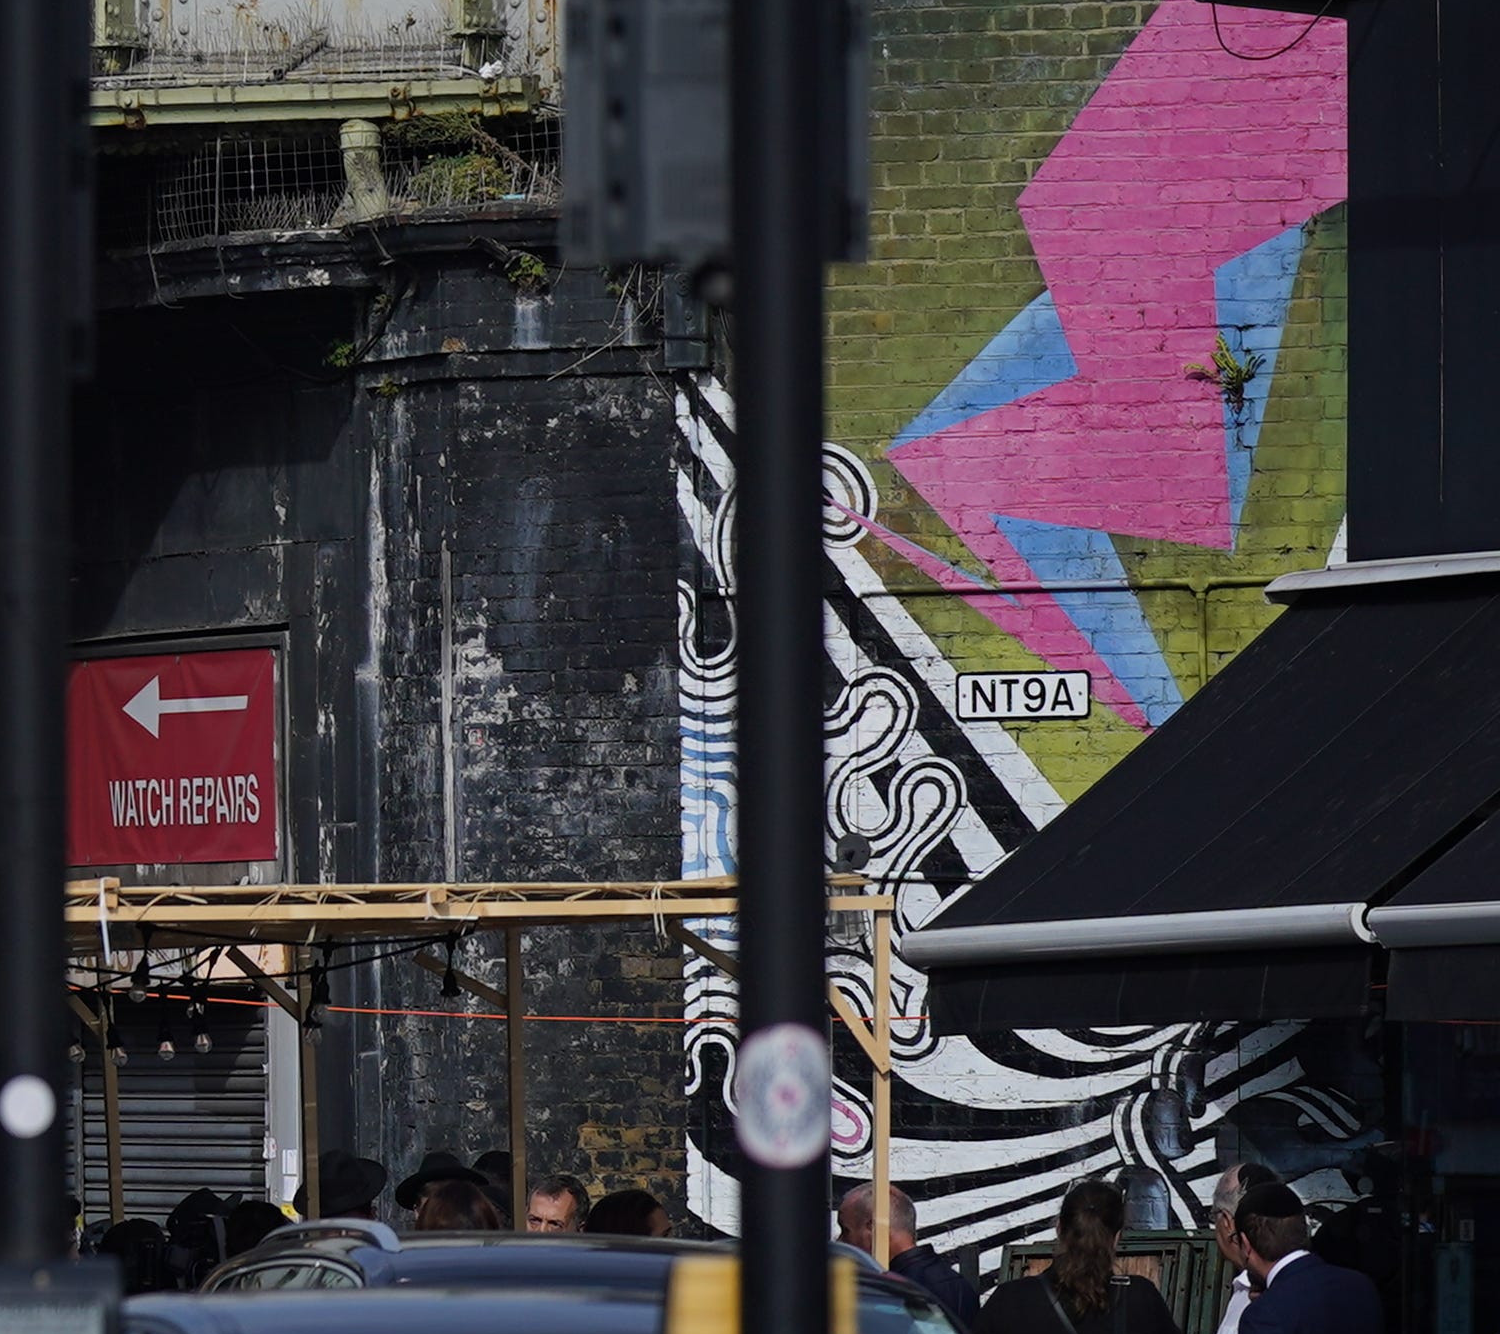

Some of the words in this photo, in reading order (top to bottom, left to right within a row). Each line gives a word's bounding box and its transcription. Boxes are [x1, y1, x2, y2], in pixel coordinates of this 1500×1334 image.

[971, 677, 1076, 713] NT9A
[108, 778, 175, 828] WATCH
[178, 773, 261, 825] REPAIRS
